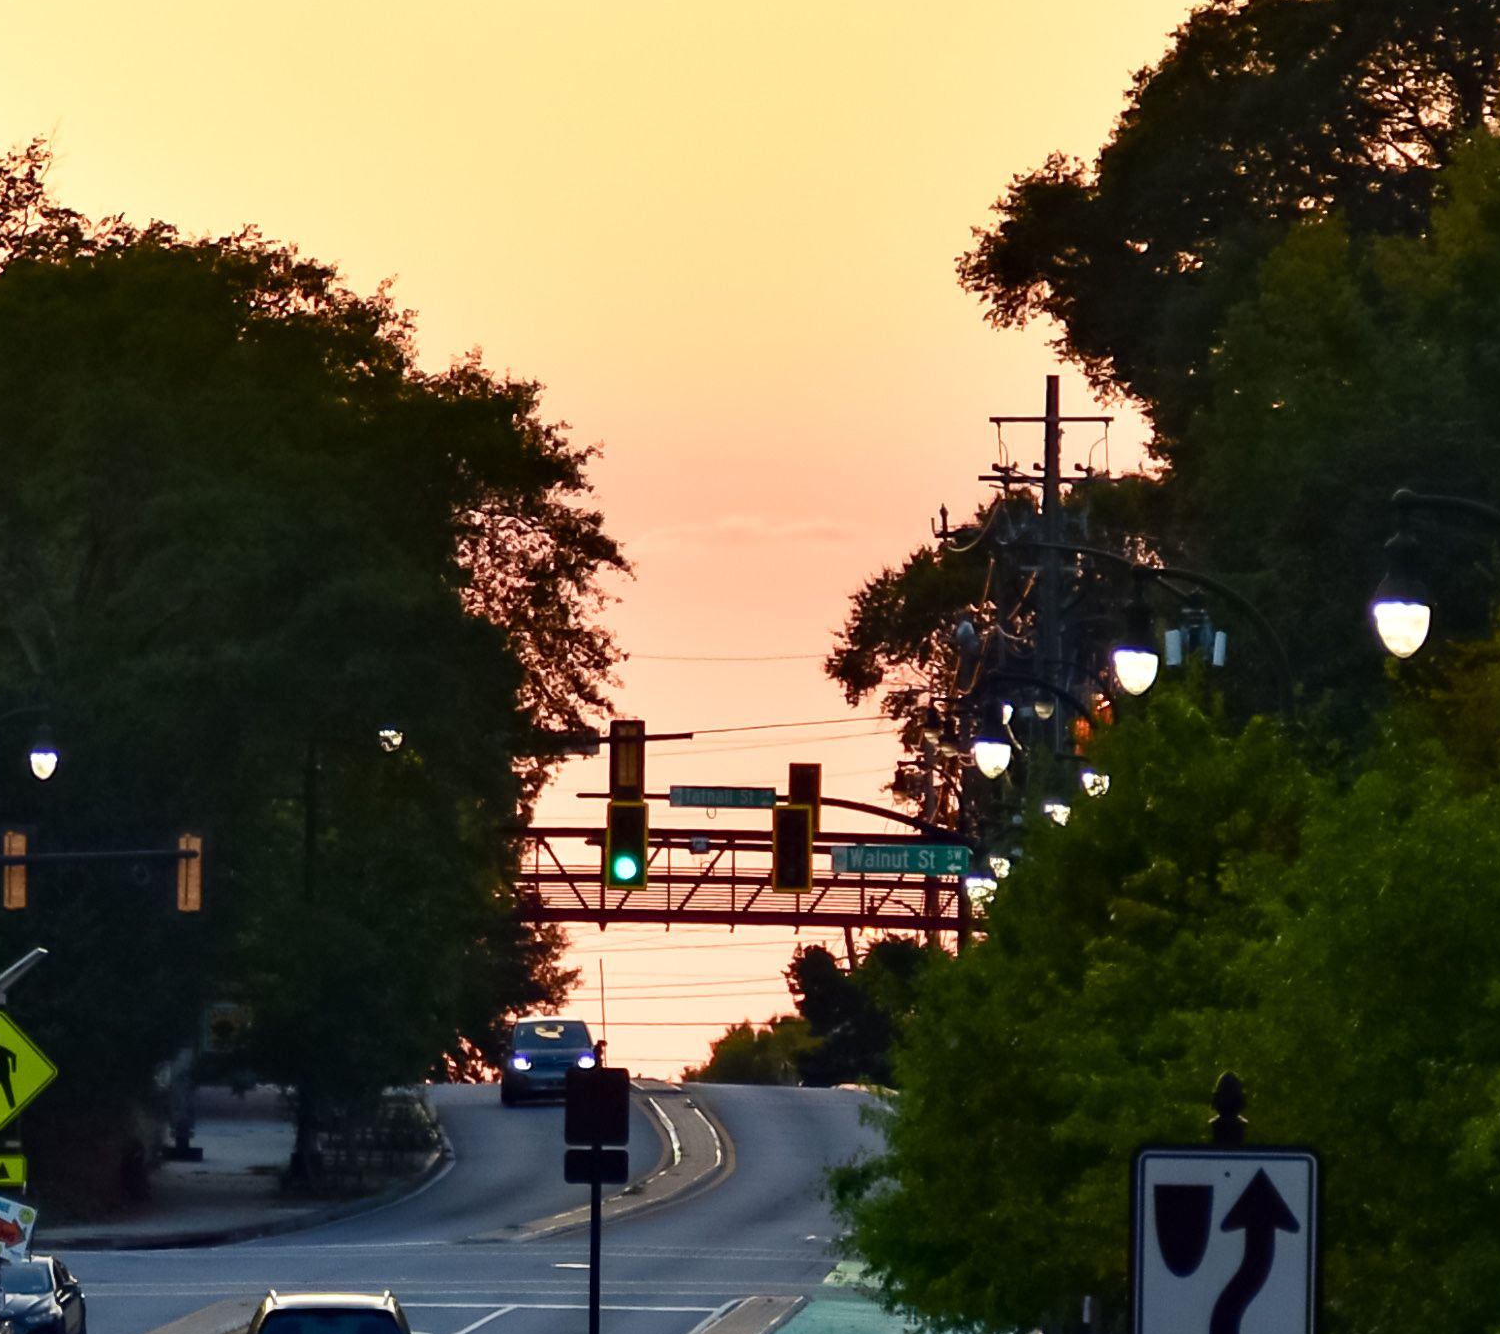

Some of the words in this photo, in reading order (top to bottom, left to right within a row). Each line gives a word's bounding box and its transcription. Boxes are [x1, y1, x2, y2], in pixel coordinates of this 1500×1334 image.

[740, 789, 754, 804] St
[850, 848, 909, 868] Walnut
[918, 849, 936, 869] St
[947, 850, 962, 860] SW
